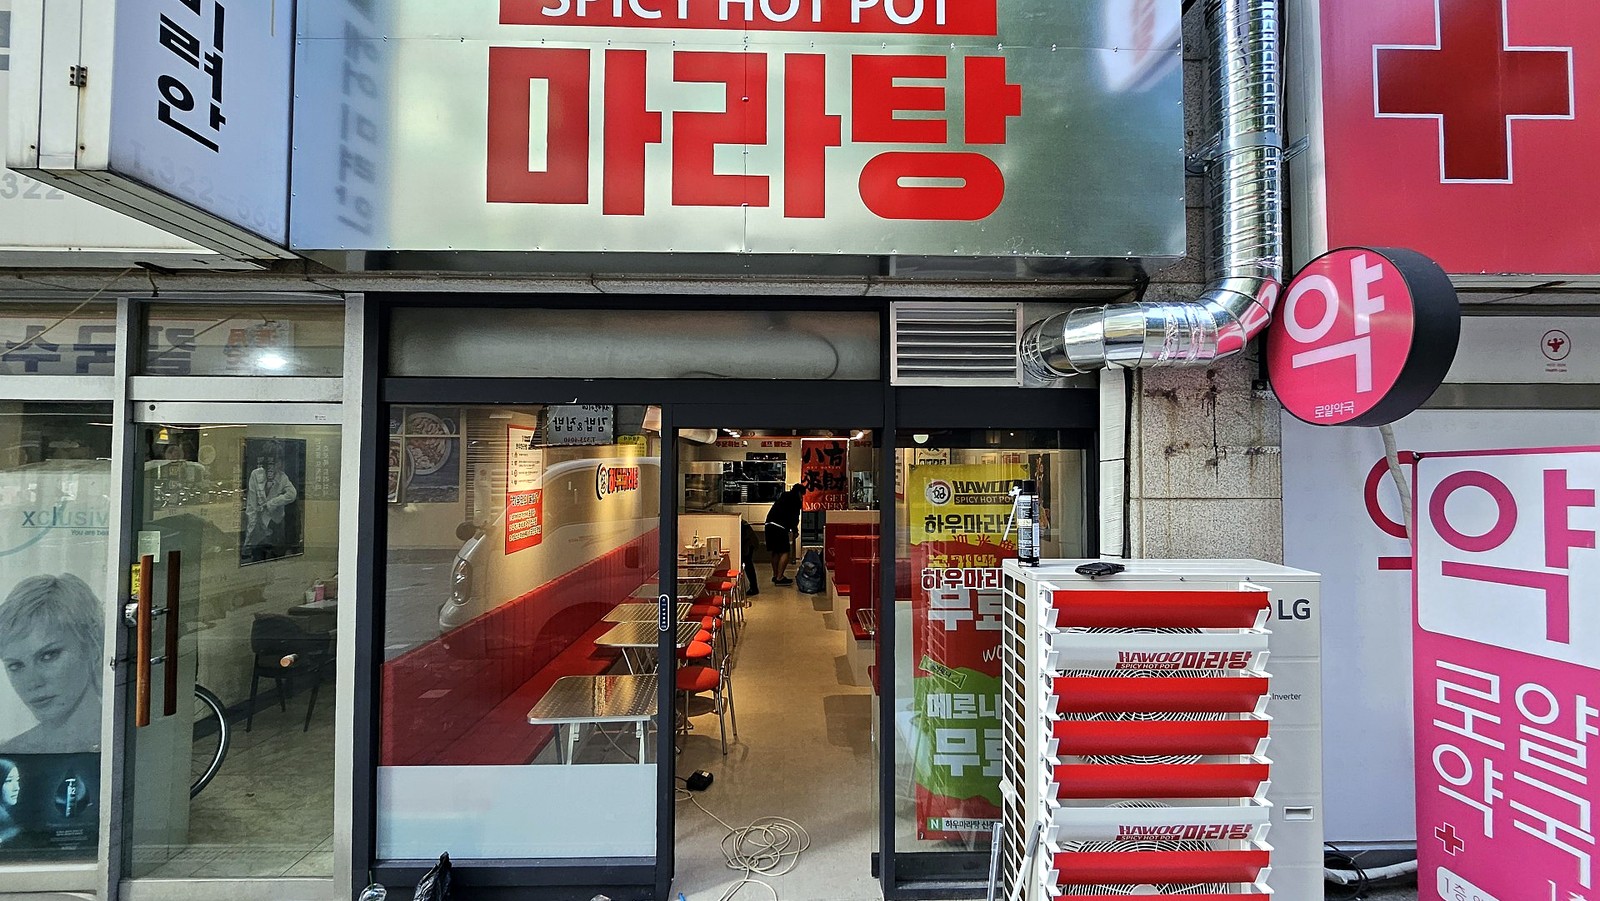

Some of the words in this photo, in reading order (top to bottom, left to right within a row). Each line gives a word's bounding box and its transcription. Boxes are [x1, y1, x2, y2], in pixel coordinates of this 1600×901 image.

[487, 47, 1022, 221] 마라탕
[1283, 254, 1385, 393] 약
[1314, 401, 1355, 419] 로얄약국
[825, 493, 846, 502] GET
[955, 495, 980, 504] SPICY
[980, 495, 997, 504] HOT
[1429, 468, 1595, 644] 약
[1278, 599, 1311, 620] LG
[1118, 651, 1184, 663] HAWOO
[1182, 651, 1253, 669] 마라탕
[1272, 692, 1302, 701] Inverter
[1433, 660, 1599, 784] 로얄
[930, 819, 939, 829] N
[945, 819, 979, 830] 하우마라탕
[1432, 743, 1595, 889] 약국
[1118, 825, 1185, 835] HAWOO
[1183, 824, 1253, 840] 마라탕
